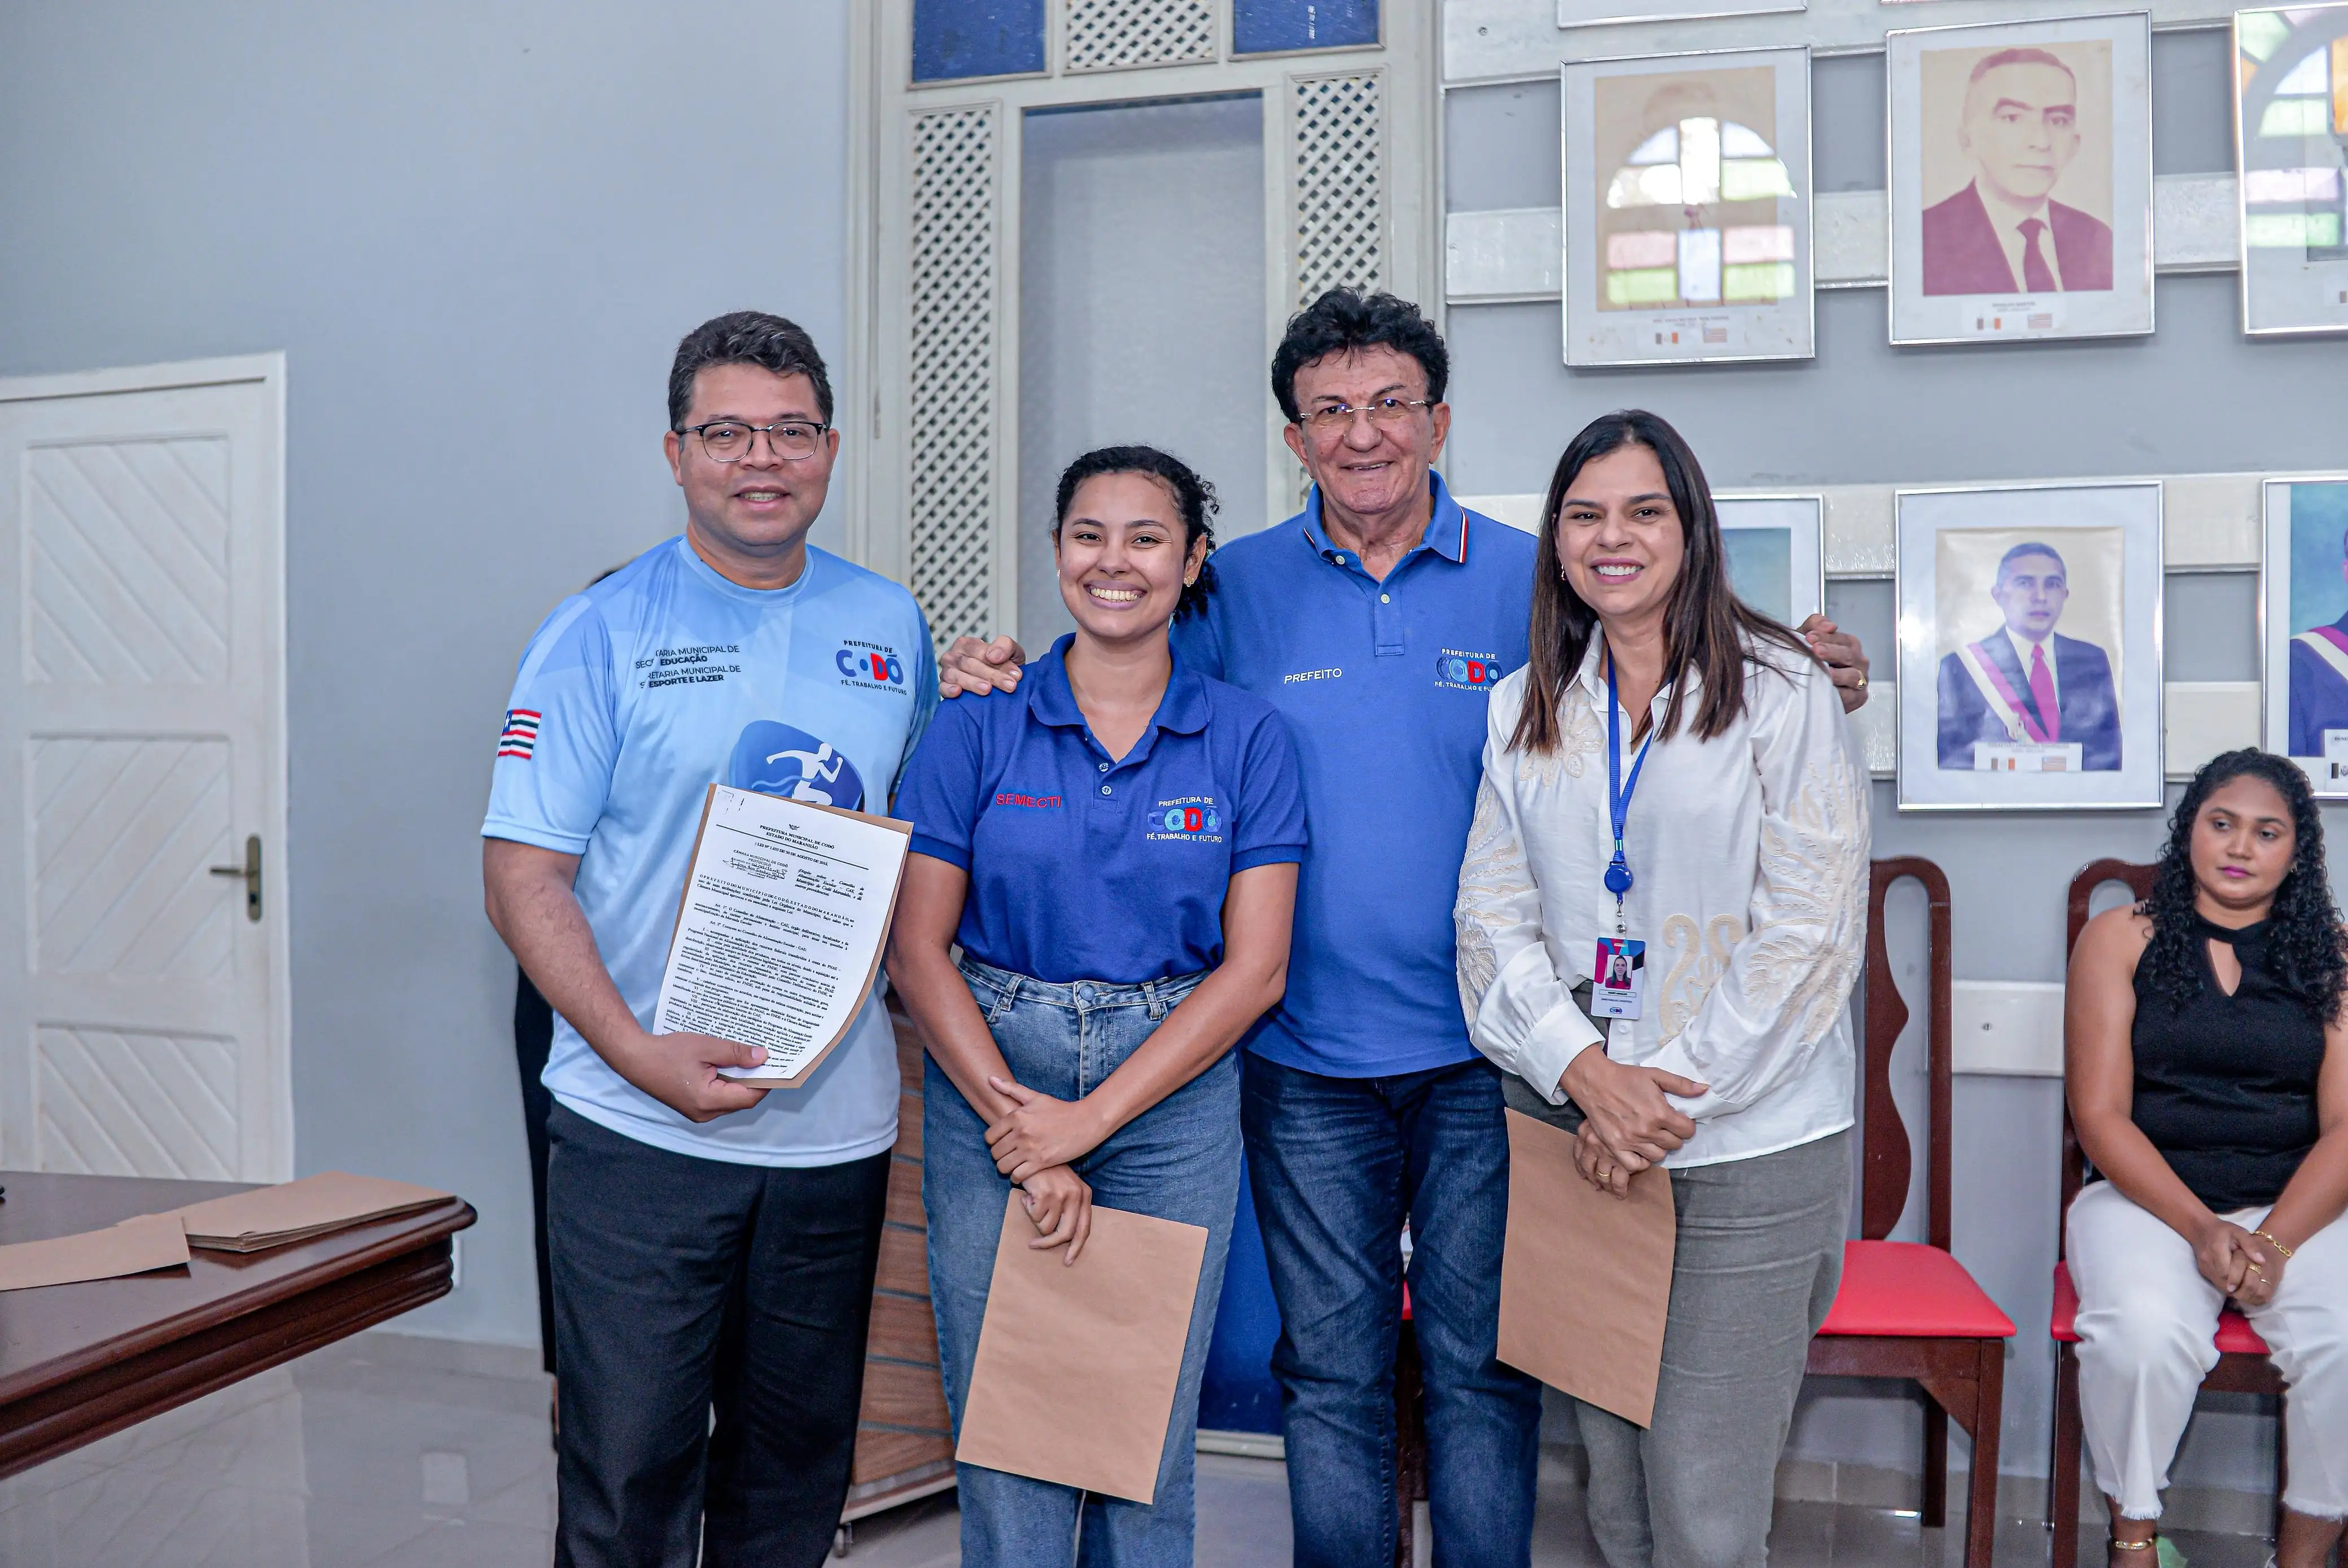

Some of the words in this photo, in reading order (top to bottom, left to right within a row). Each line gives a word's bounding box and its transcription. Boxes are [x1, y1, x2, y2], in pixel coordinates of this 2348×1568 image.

[679, 647, 726, 655] MUNICIPAL
[844, 640, 883, 651] PREFEITURA
[660, 653, 708, 666] EDUCAÇÃO
[1442, 649, 1484, 659] PREFEITURA
[682, 666, 728, 675] MUNICIPAL
[836, 649, 904, 685] CODÓ
[1284, 668, 1343, 684] PREFEITO
[649, 677, 688, 688] ESPORTE
[852, 681, 882, 690] TRABALHO
[888, 686, 907, 695] FUTURO
[1446, 682, 1477, 691] TRABALHO
[996, 793, 1062, 808] SEMECTI
[1158, 796, 1201, 807] PREFEITURA
[1147, 805, 1223, 833] CODÓ
[760, 825, 787, 836] PREFEITURA
[788, 833, 814, 843] MUNICIPAL
[766, 831, 784, 840] ESTADO
[792, 839, 818, 849] MARANHÃO
[748, 858, 771, 867] PROTOCOLO
[750, 854, 770, 863] MUNICIPAL
